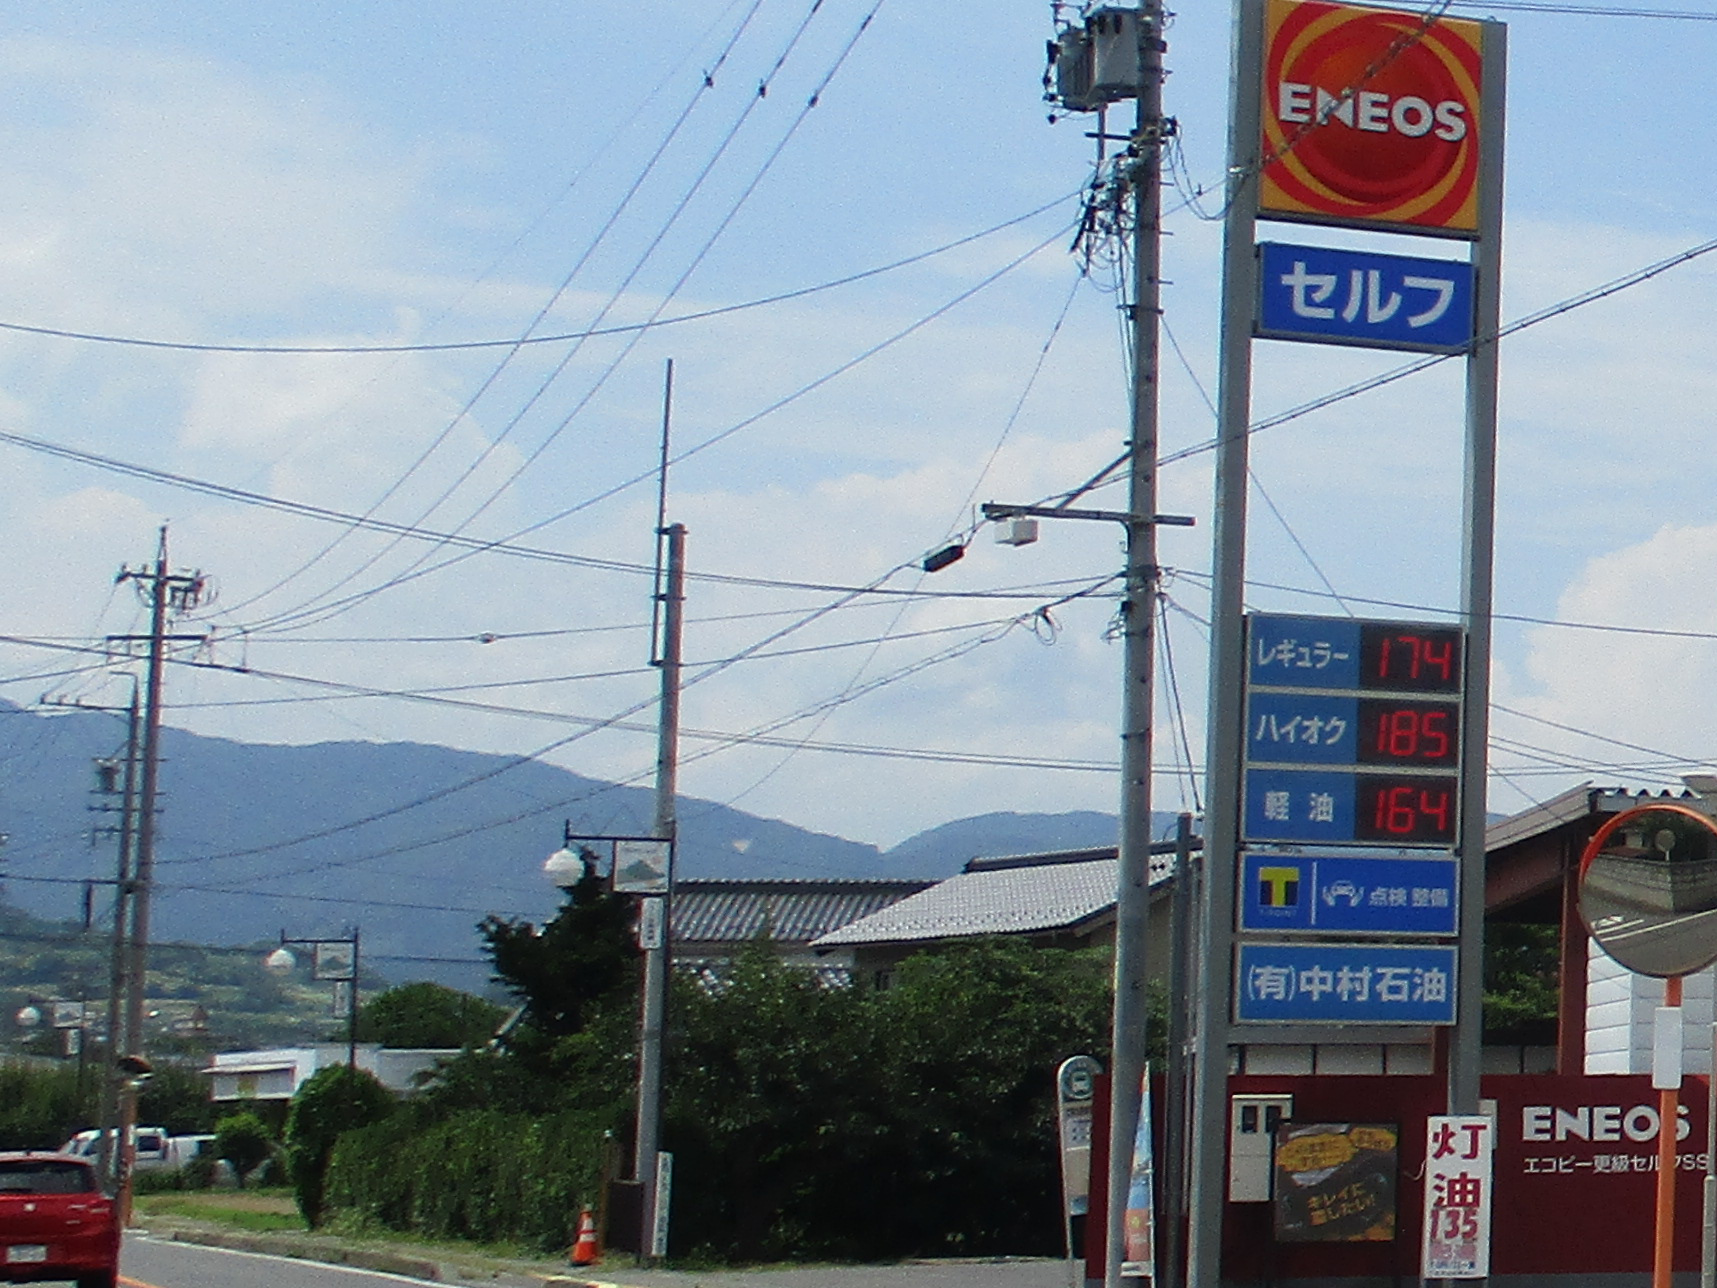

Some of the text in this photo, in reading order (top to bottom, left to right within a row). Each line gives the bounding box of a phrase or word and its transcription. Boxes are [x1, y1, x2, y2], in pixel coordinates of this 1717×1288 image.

[1278, 81, 1467, 142] ENEOS
[1281, 261, 1455, 329] セルフ
[1257, 638, 1350, 669] レギュラー
[1379, 636, 1451, 680] 174
[1256, 714, 1347, 746] ハイオク
[1377, 710, 1449, 758] 185
[1375, 787, 1447, 834] 164
[1432, 1123, 1487, 1208] 灯油
[1523, 1154, 1710, 1174] エコピー更級セルSS
[1430, 1209, 1478, 1240] 135
